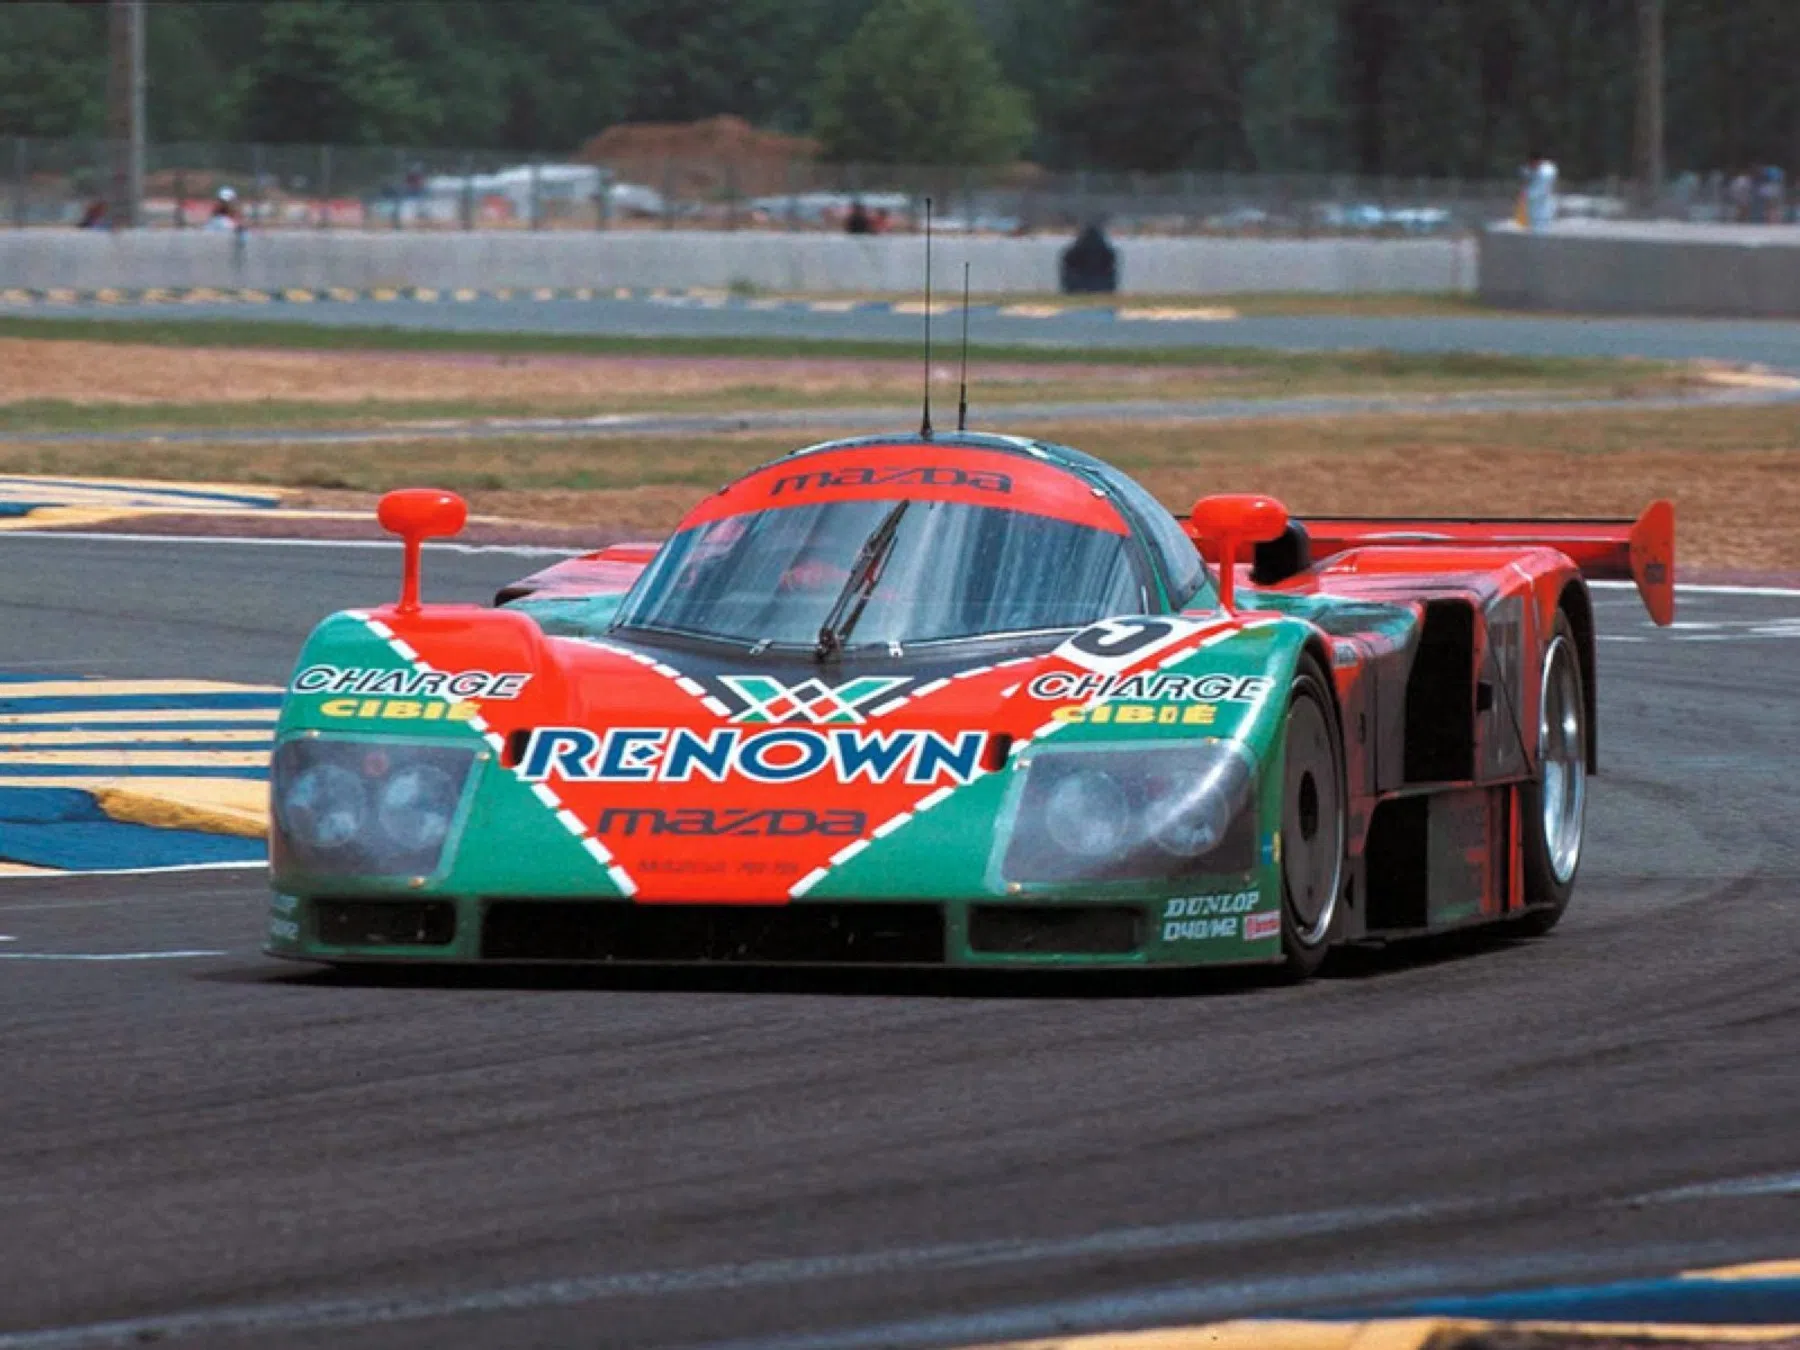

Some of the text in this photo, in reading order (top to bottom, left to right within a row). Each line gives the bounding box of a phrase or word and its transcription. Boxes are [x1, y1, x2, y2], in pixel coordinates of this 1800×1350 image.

[293, 664, 533, 698] CHARGE
[1029, 672, 1274, 701] CHARGE
[518, 727, 988, 785] RENOWN
[1163, 891, 1260, 918] DUNLOP
